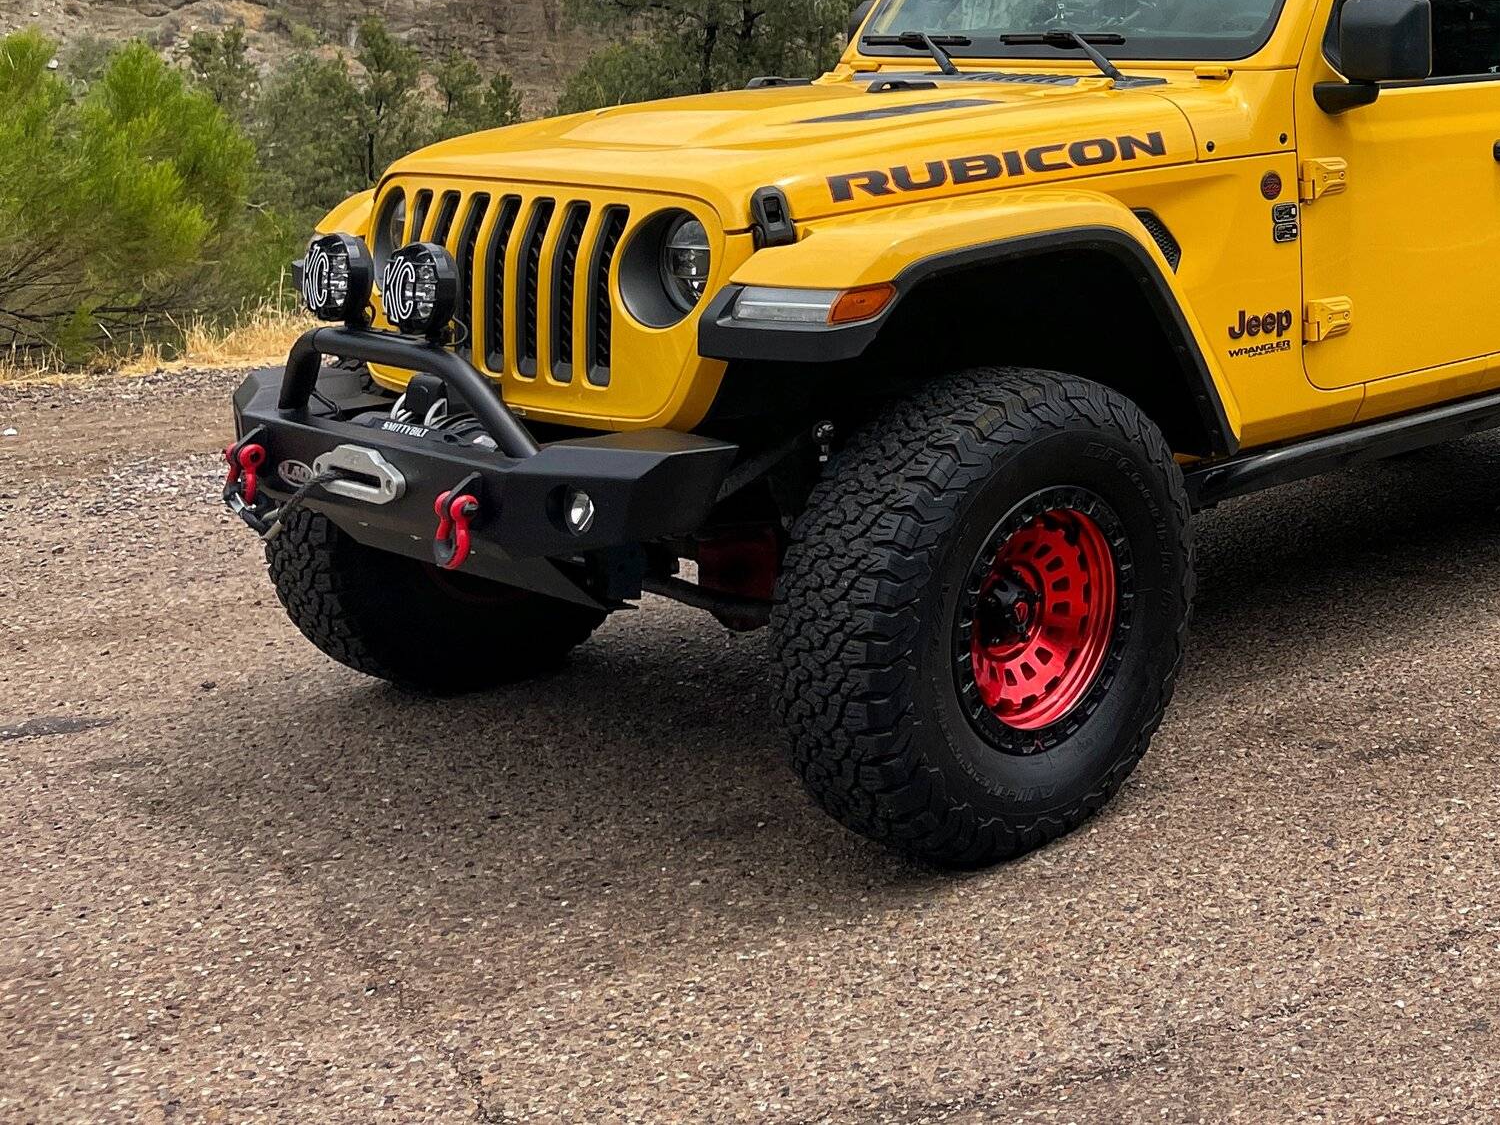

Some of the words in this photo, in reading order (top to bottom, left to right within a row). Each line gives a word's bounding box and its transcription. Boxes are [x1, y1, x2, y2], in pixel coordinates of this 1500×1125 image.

[828, 132, 1166, 203] RUBICON
[303, 245, 329, 310] KC
[383, 256, 415, 322] KC
[1228, 309, 1292, 339] Jeep
[1228, 340, 1291, 358] WRANGLER
[381, 421, 430, 438] SMITTYBILT
